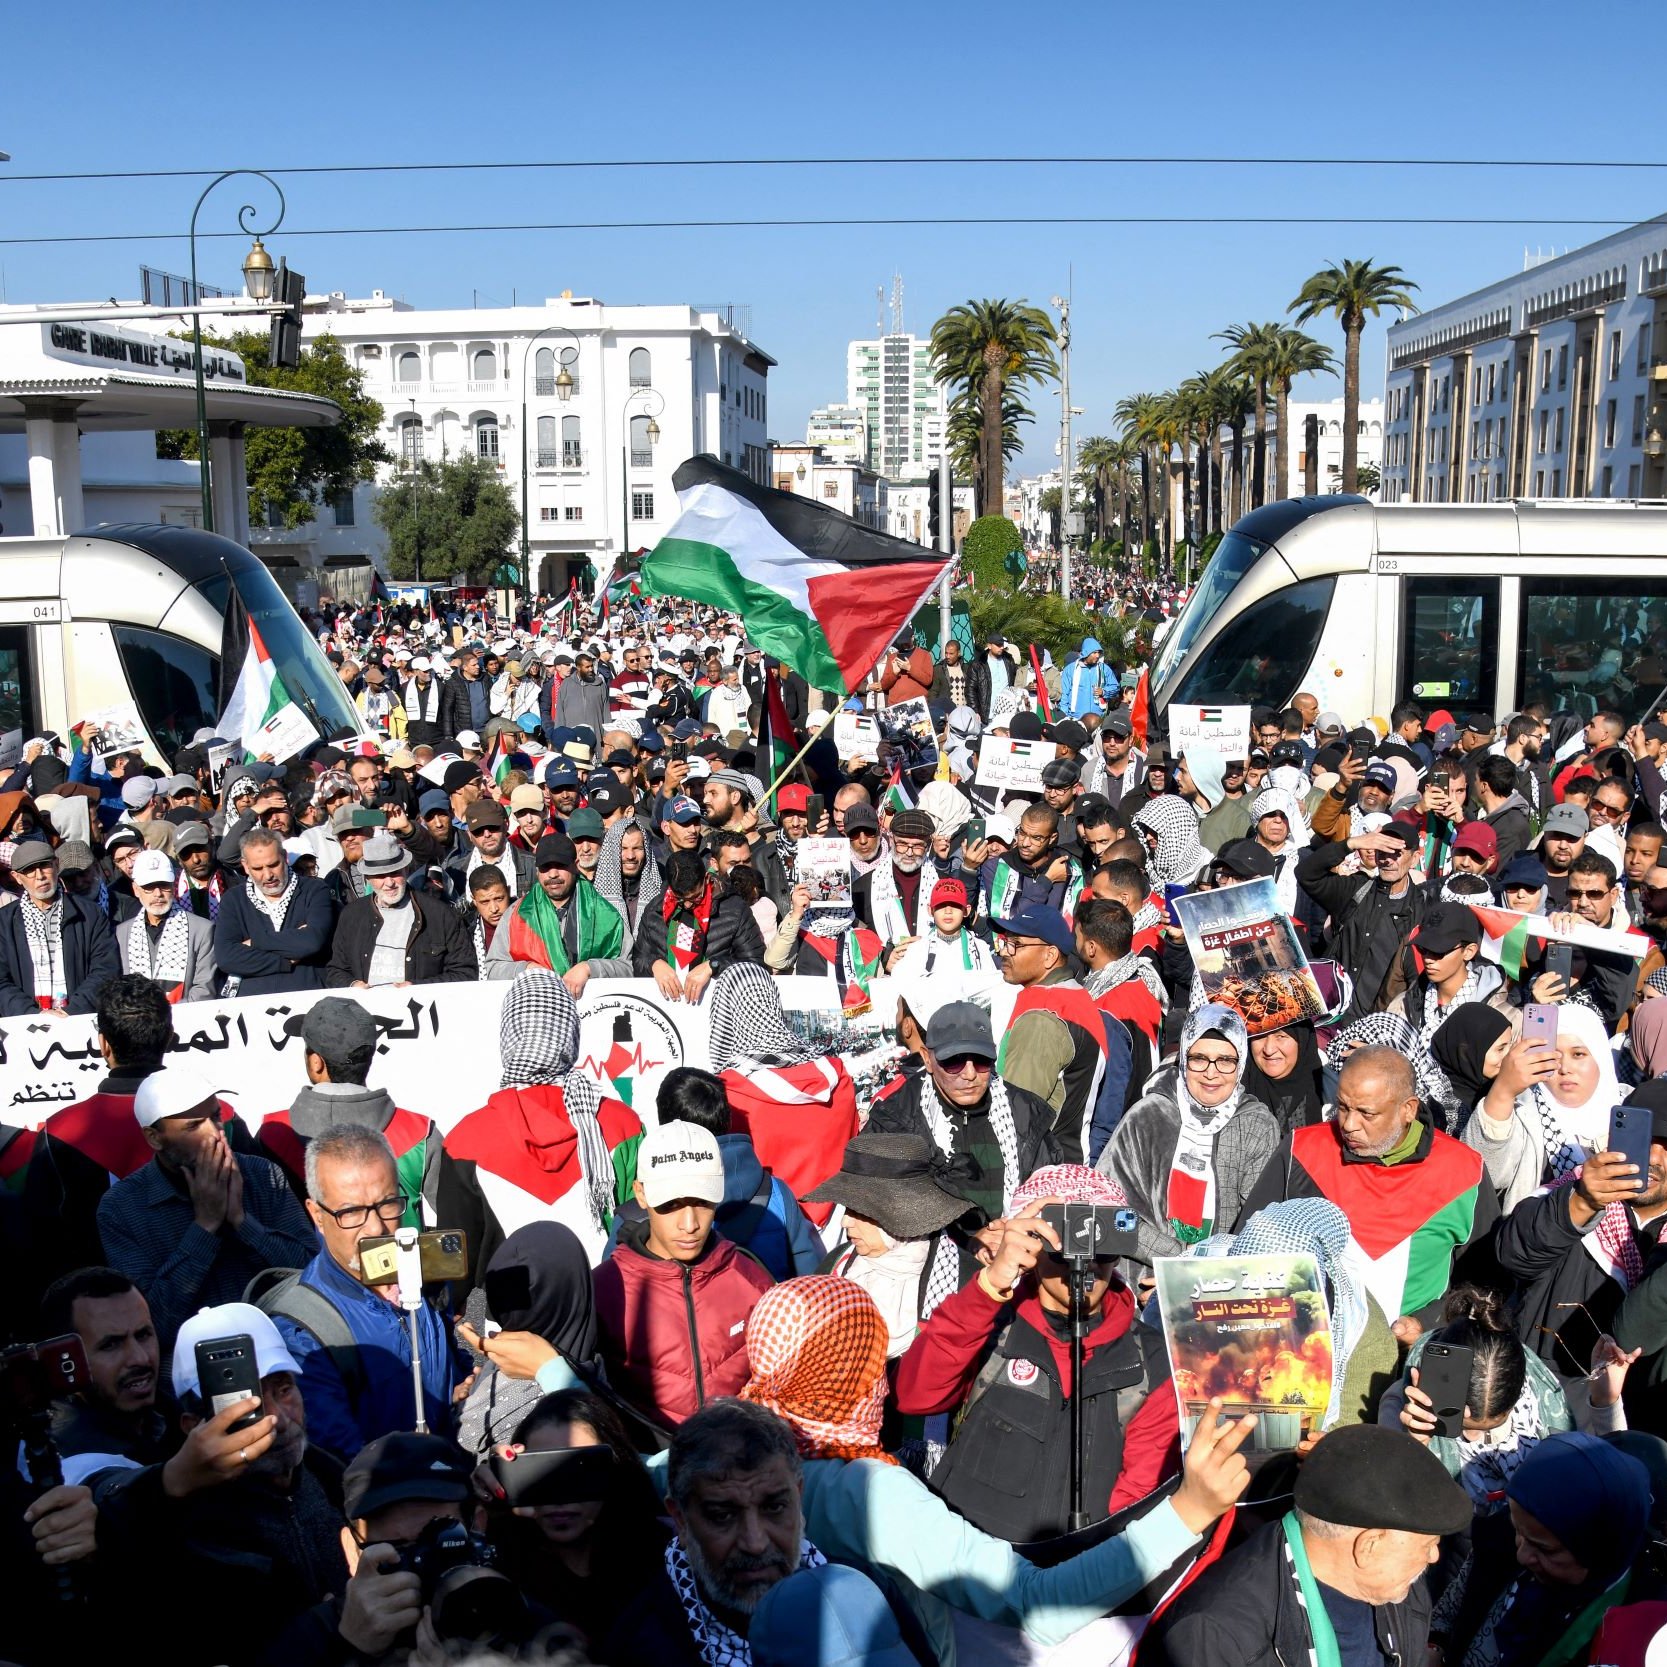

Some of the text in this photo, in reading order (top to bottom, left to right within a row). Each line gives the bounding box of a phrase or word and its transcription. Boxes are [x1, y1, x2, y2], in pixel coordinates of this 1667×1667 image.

[51, 324, 159, 367] GARE RABAT VILLE
[1378, 560, 1398, 570] 023
[33, 606, 55, 618] 041
[1180, 725, 1242, 740] فلسطين أمانة
[1219, 743, 1243, 753] والتط
[988, 755, 1010, 767] أمانة
[984, 770, 1043, 787] التطبيع خيانة
[1198, 917, 1225, 932] الحصار
[1204, 926, 1272, 948] عن اطفال غزة
[593, 1001, 621, 1014] فلسطين
[622, 1003, 644, 1013] لدعم
[643, 1009, 670, 1035] المغربية
[665, 1034, 679, 1059] الجبهة
[9, 1081, 76, 1107] تنظم
[651, 1150, 714, 1168] Palm Angels
[1190, 1276, 1237, 1299] حصار
[1194, 1298, 1291, 1321] غزة تحت النار
[442, 1540, 466, 1548] Nikon
